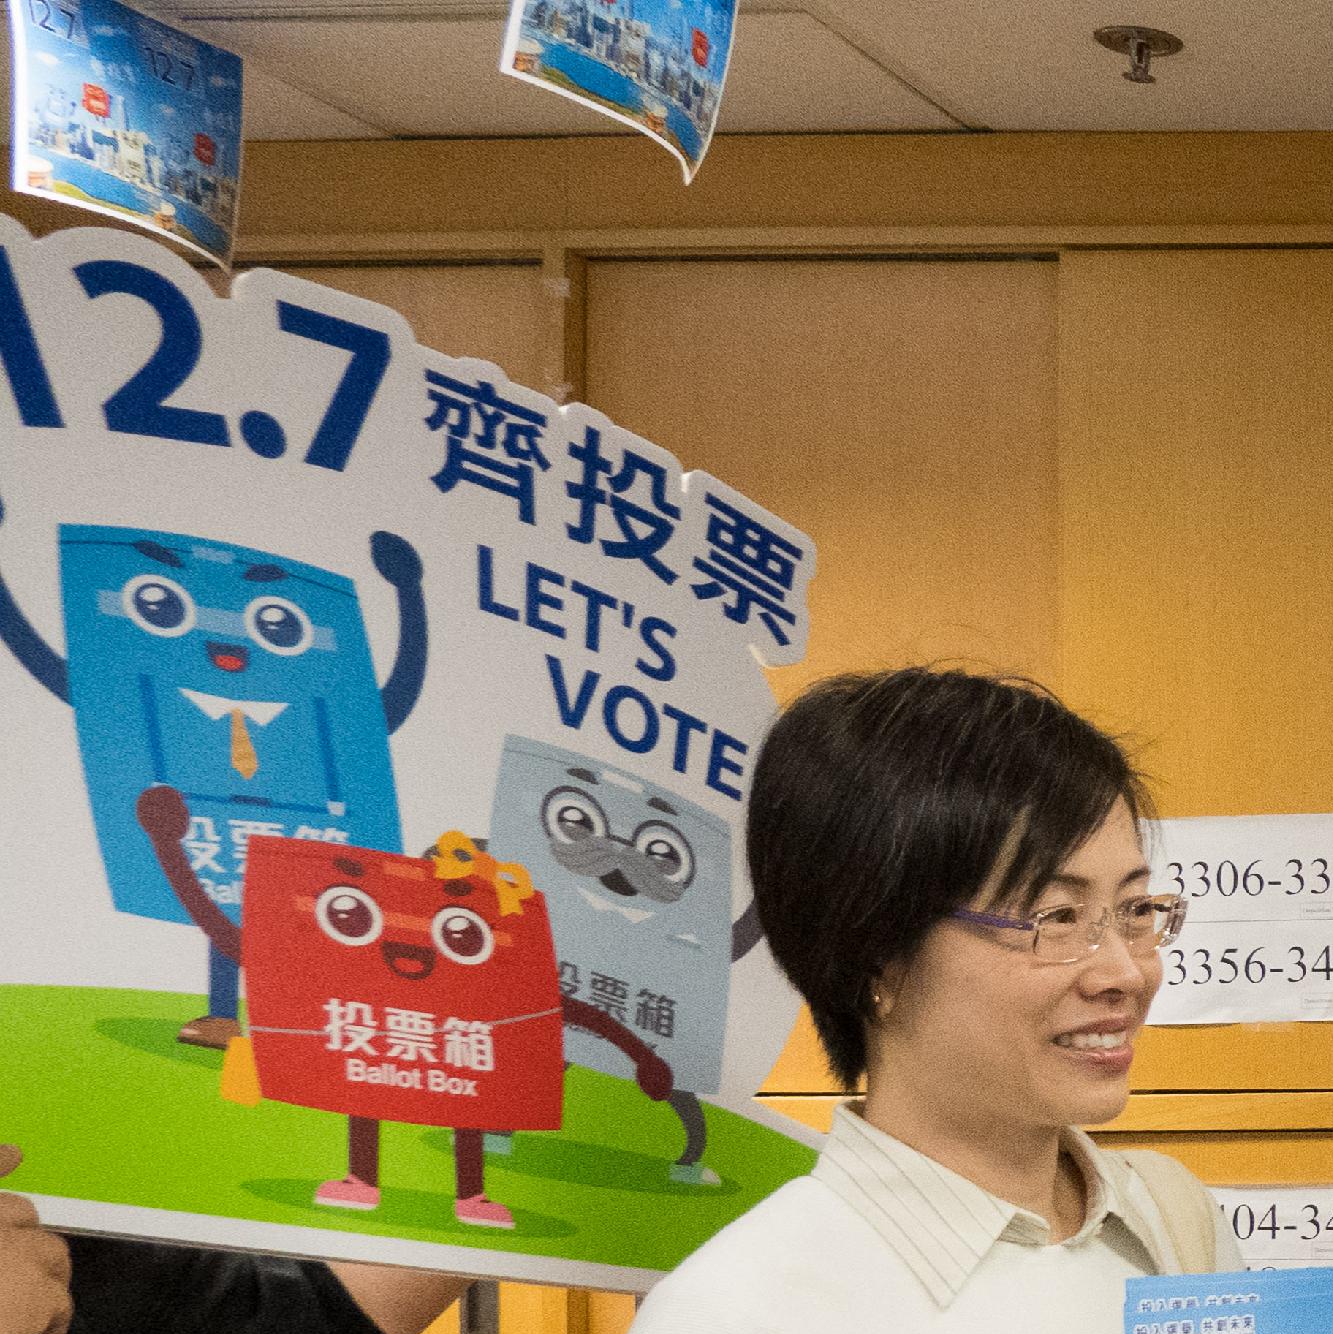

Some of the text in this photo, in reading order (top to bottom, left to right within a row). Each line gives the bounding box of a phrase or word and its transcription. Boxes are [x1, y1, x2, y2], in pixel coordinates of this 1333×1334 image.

[0, 245, 803, 647] 12.7 齊投票
[477, 544, 677, 682] LET'S
[545, 653, 750, 802] VOTE
[323, 998, 495, 1071] 投票箱
[346, 1058, 479, 1097] Ballot Box
